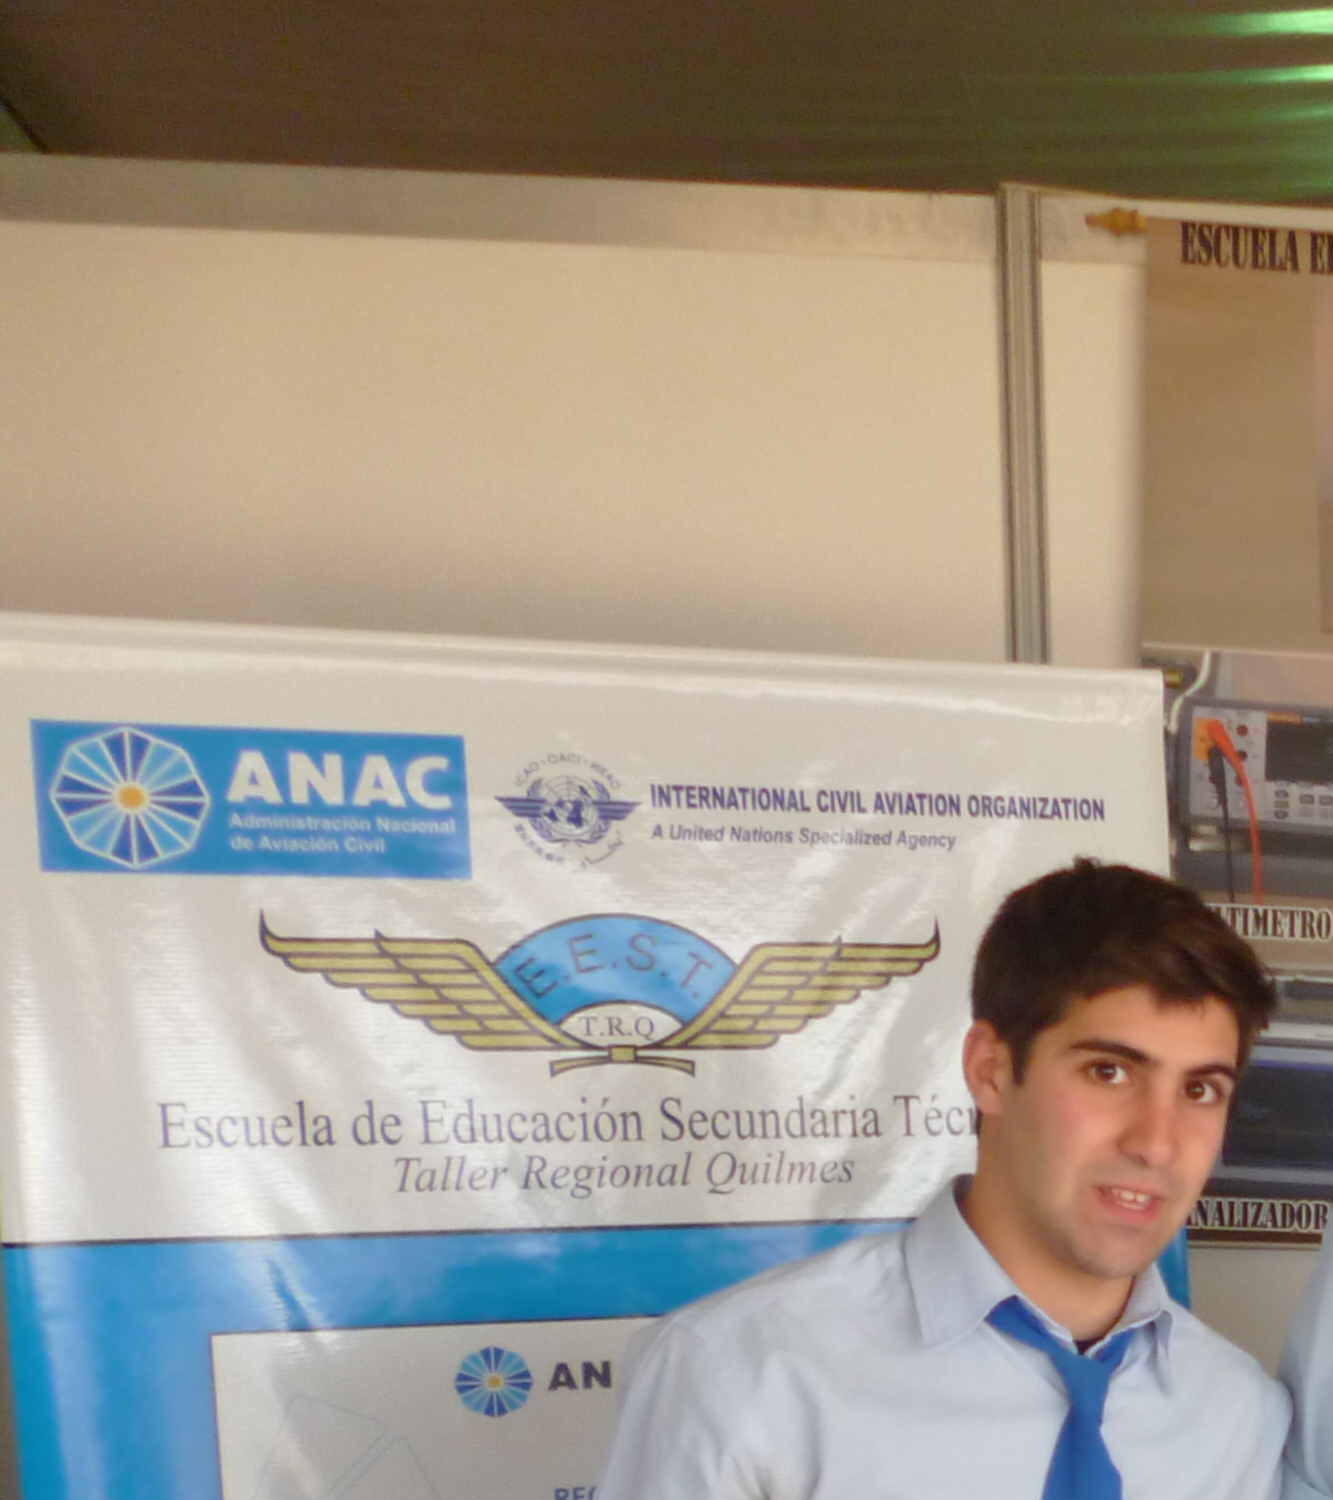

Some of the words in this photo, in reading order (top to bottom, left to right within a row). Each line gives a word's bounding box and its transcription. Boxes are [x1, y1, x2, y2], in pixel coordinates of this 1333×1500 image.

[1180, 220, 1300, 272] ESCUELA
[226, 750, 454, 809] ANAC
[650, 783, 812, 813] INTERNATIONAL
[816, 788, 868, 814] CIVIL
[873, 791, 962, 817] AVIATION
[966, 794, 1105, 821] ORGANIZATION
[228, 812, 372, 832] Administración
[375, 816, 458, 835] Nacional
[229, 833, 255, 851] de
[257, 833, 340, 852] Aviación
[342, 834, 386, 854] Civil
[651, 822, 664, 840] A
[668, 822, 726, 841] United
[729, 825, 794, 844] Nations
[800, 827, 892, 848] Specialized
[897, 830, 957, 852] Agency
[513, 933, 713, 999] E.E.S.T.
[158, 1099, 336, 1149] Escuela
[351, 1098, 402, 1147] de
[418, 1096, 645, 1145] Educación
[659, 1094, 882, 1142] Secundaria
[394, 1155, 510, 1193] Taller
[519, 1151, 694, 1198] Regional
[705, 1150, 859, 1196] Quilmes
